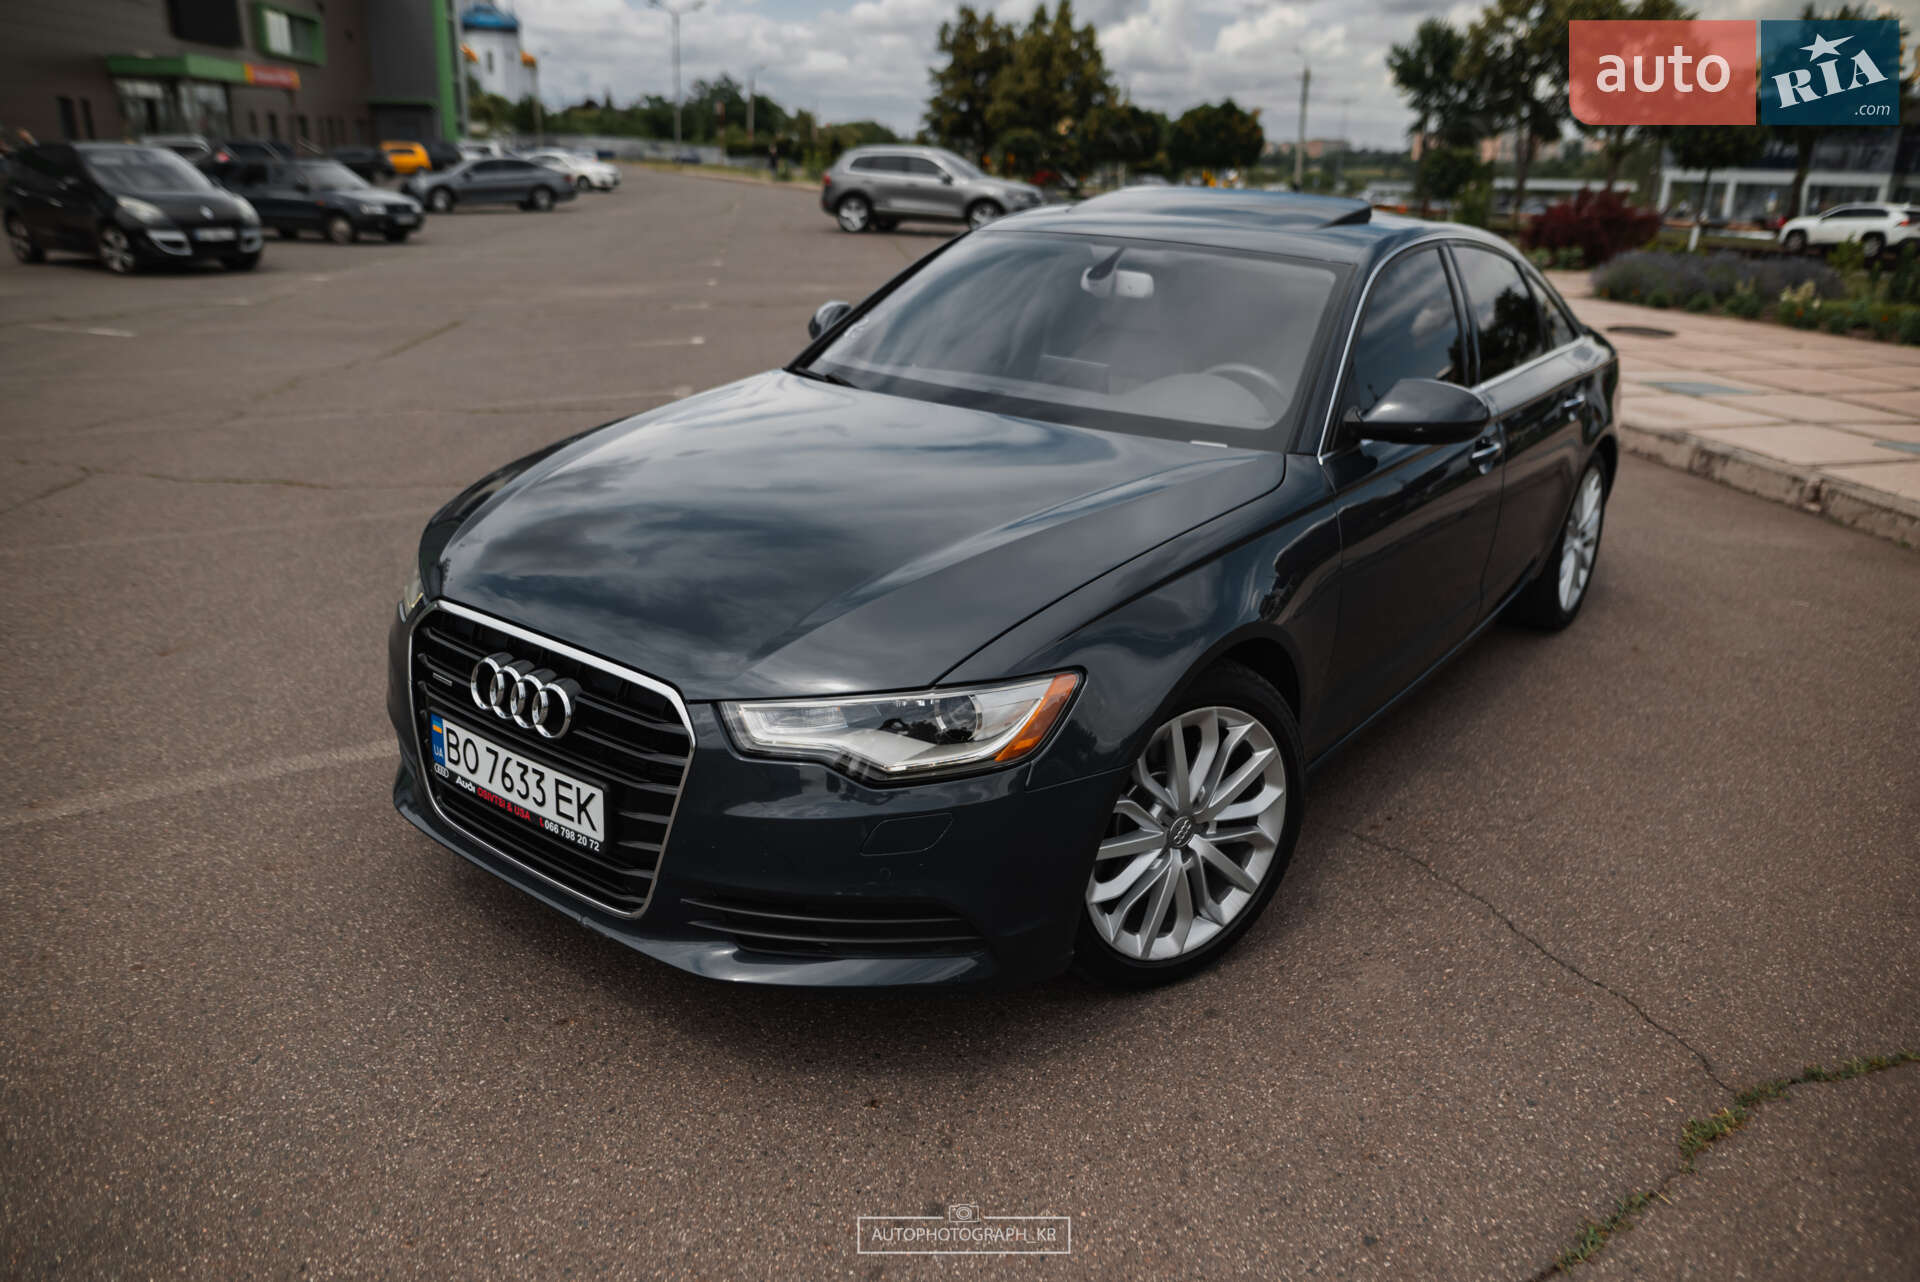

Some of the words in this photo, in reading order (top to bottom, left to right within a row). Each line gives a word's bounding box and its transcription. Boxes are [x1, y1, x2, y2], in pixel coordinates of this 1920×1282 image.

[433, 744, 444, 758] UA
[446, 727, 479, 775] BO
[485, 746, 546, 807] 7633
[555, 778, 597, 832] EK
[456, 776, 476, 793] Audi
[514, 805, 530, 821] USA
[544, 820, 559, 834] 066
[560, 827, 576, 841] 798
[577, 834, 588, 846] 20
[589, 838, 600, 852] 72
